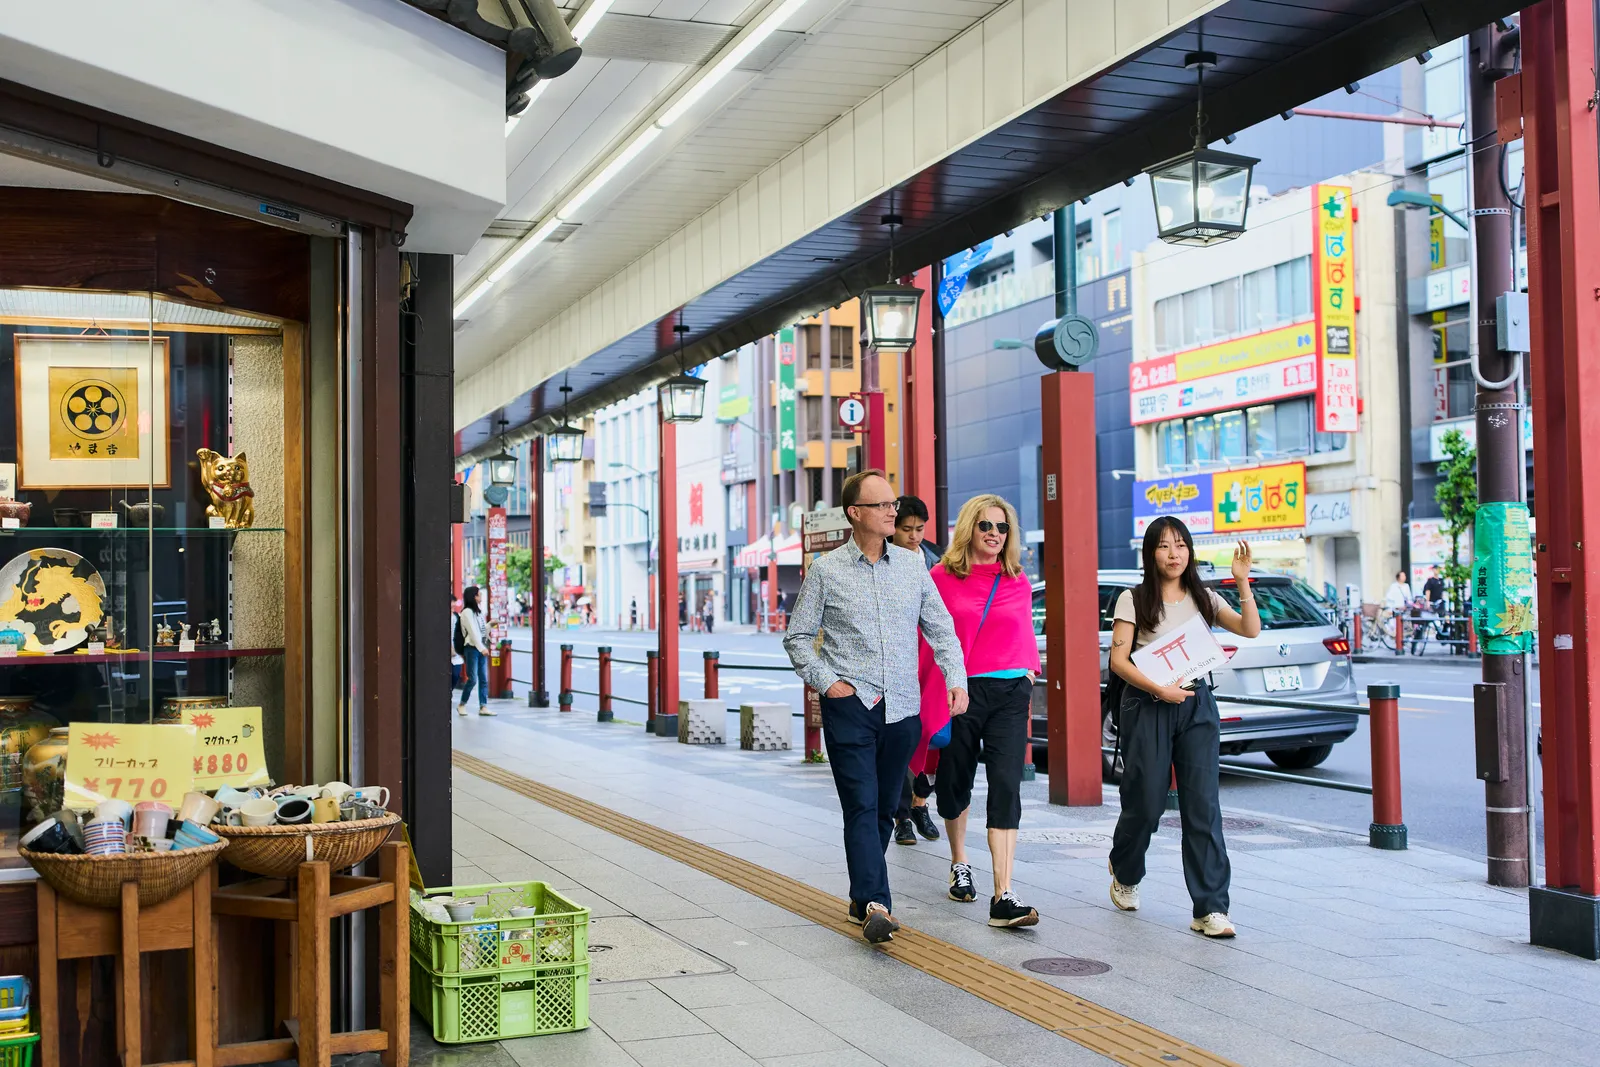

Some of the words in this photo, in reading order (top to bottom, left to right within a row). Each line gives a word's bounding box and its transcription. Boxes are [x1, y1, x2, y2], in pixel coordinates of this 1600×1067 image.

[1329, 363, 1350, 378] Tax
[1327, 380, 1353, 394] Free
[1190, 515, 1210, 525] Shop
[1477, 566, 1488, 598] 台東区
[1197, 657, 1216, 669] Stars
[204, 735, 238, 746] マグカップ
[94, 757, 158, 768] フリーカップ
[193, 752, 248, 774] ¥880
[83, 777, 168, 799] ¥770
